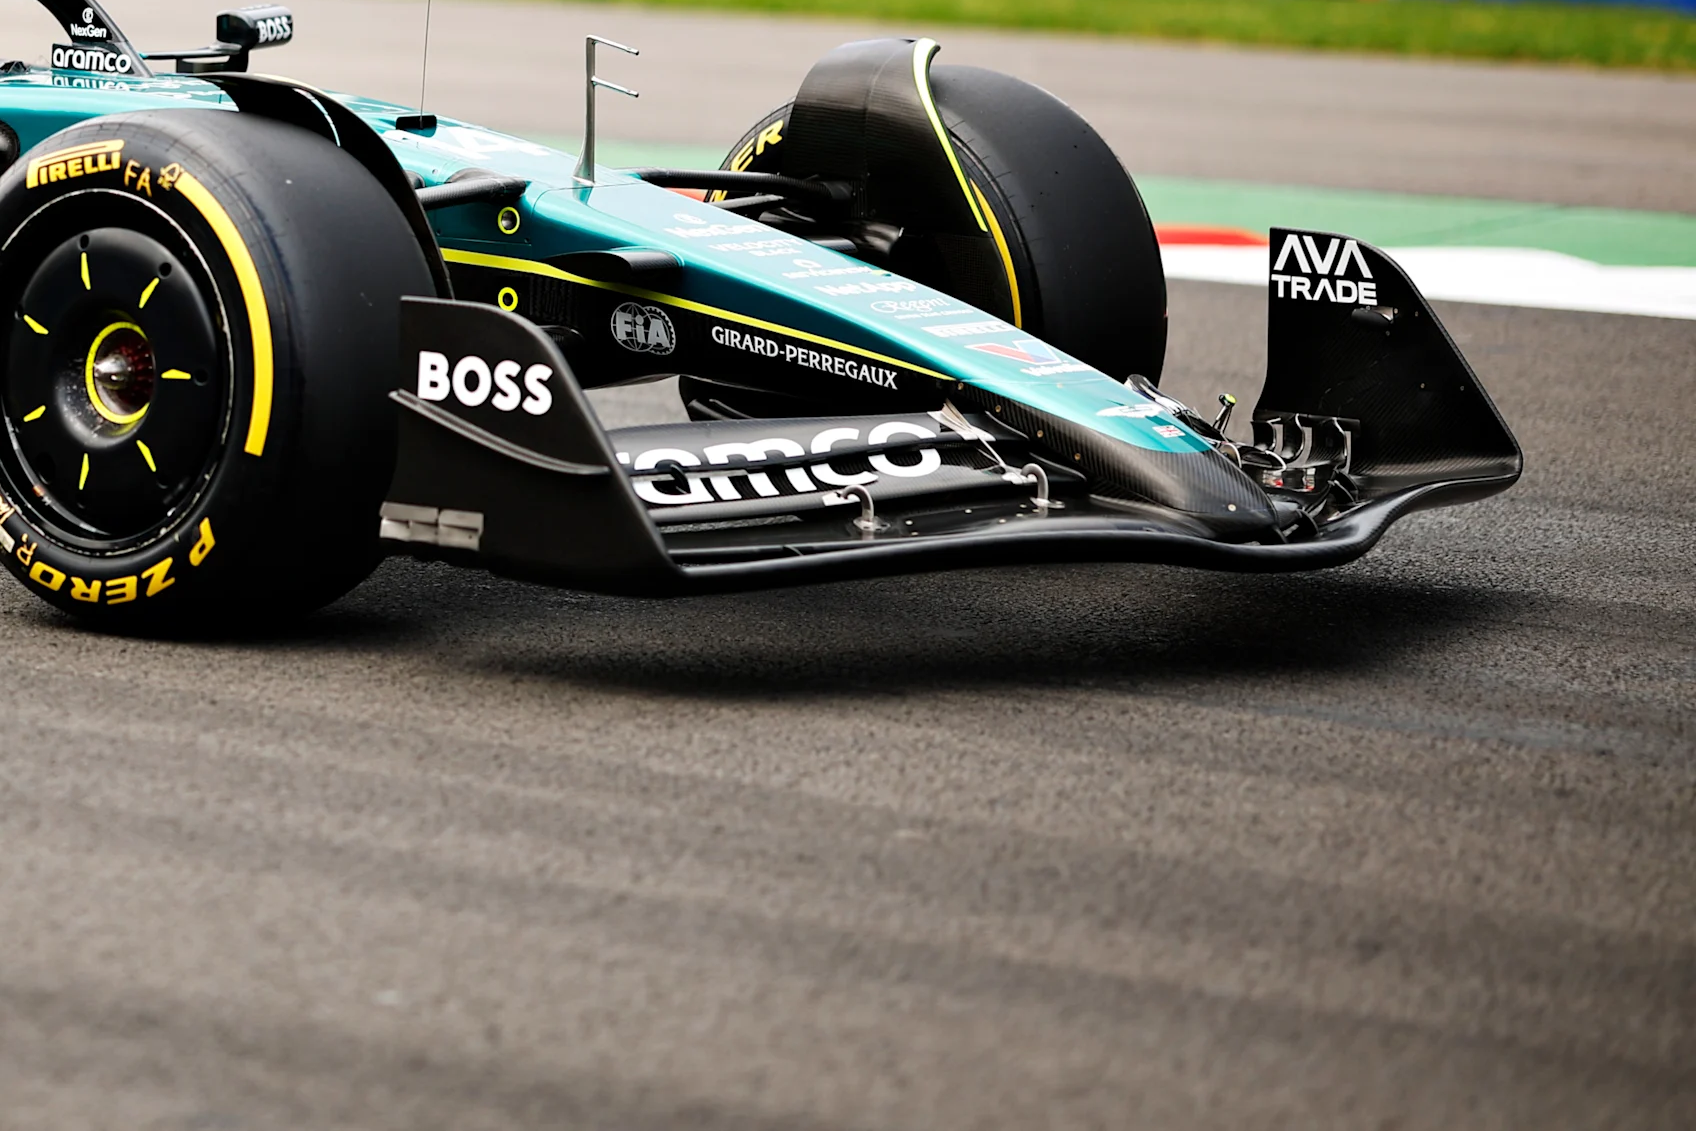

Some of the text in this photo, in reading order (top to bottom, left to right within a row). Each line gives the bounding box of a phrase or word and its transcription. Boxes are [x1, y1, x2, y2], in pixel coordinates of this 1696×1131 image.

[70, 23, 107, 38] NexGen
[257, 16, 292, 43] BOSS
[52, 47, 132, 73] aramco
[26, 139, 125, 189] PIRELLI
[1273, 234, 1373, 279] AVA
[1271, 273, 1378, 306] TRADE
[711, 325, 899, 390] GIRARD-PERREGAUX
[416, 350, 554, 416] BOSS
[616, 421, 943, 505] amco
[29, 517, 216, 605] P ZERO
